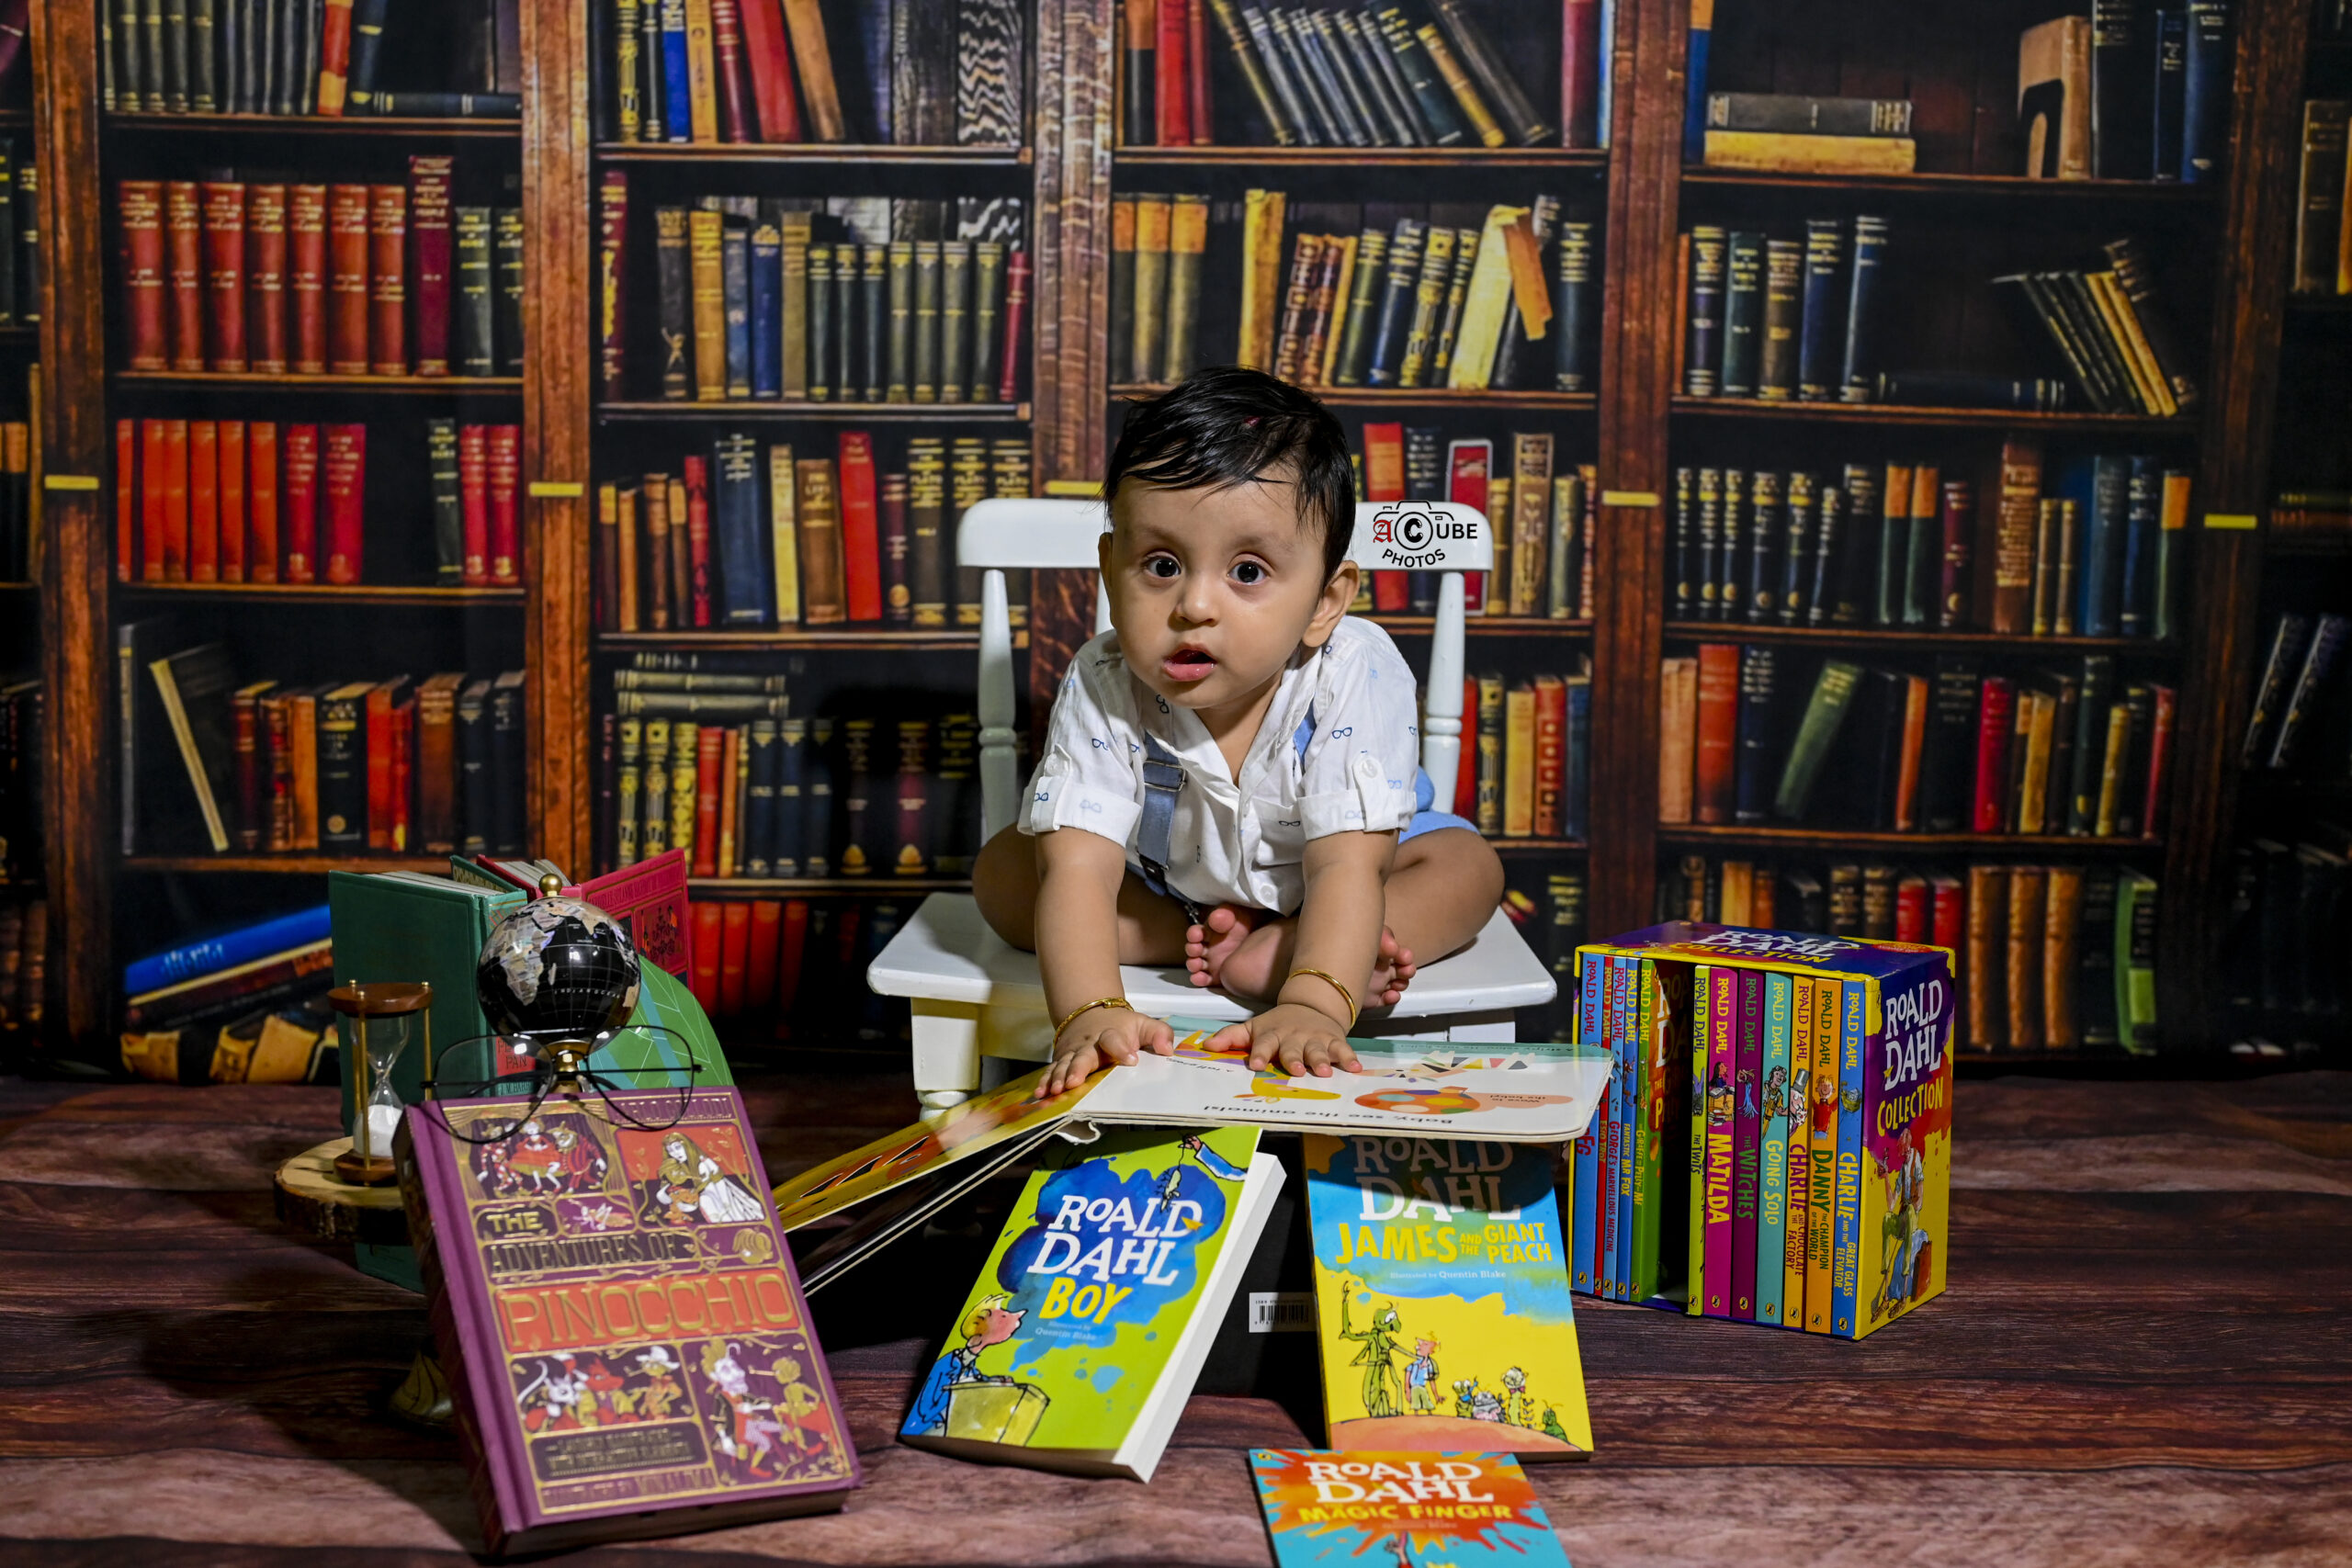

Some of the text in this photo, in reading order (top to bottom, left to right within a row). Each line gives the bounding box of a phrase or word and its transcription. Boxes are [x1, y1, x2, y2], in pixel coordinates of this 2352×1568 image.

[1669, 942, 1831, 964] COLLECTION
[1690, 935, 1836, 957] DAHL
[1719, 930, 1860, 950] ROALD
[1585, 960, 1597, 1035] ROALD DAHL
[1602, 967, 1612, 1041] ROALD DAHL
[1612, 967, 1624, 1042] ROALD DAHL
[1625, 969, 1637, 1043] ROALD DAHL
[1639, 969, 1651, 1043] ROALD DAHL
[1693, 977, 1706, 1053] ROALD DAHL
[1716, 977, 1729, 1054] ROALD DAHL
[1744, 977, 1757, 1054] ROALD DAHL
[1771, 982, 1784, 1058] ROALD DAHL
[1885, 979, 1943, 1040] ROALD
[1796, 985, 1809, 1062] ROALD DAHL
[1819, 990, 1832, 1067] ROALD DAHL
[1846, 992, 1860, 1070] ROALD DAHL
[1884, 1024, 1941, 1091] DAHL
[1877, 1077, 1943, 1136] COLLECTION
[1351, 1136, 1514, 1173] ROALD
[1577, 1127, 1595, 1156] FG
[1690, 1145, 1702, 1174] TWITS
[1621, 1177, 1631, 1196] FOX
[1622, 1159, 1632, 1174] MR
[1708, 1134, 1732, 1224] MATILDA
[1736, 1148, 1757, 1219] WITCHES
[1764, 1140, 1783, 1224] GOING SOLO
[1790, 1144, 1808, 1212] CHARLIE
[1811, 1149, 1833, 1213] DANNY
[1838, 1152, 1859, 1220] CHARLIE
[1356, 1176, 1521, 1223] DAHL
[1608, 1168, 1617, 1215] MARVELLOUS
[487, 1212, 543, 1232] THE
[1047, 1195, 1203, 1237] ROALD
[1460, 1233, 1482, 1244] AND
[1484, 1223, 1544, 1244] GIANT
[1606, 1217, 1615, 1252] MEDICINE
[490, 1233, 676, 1274] ADVENTURES OF
[1026, 1232, 1179, 1286] DAHL
[1336, 1223, 1457, 1263] JAMES
[1461, 1245, 1479, 1256] THE
[1487, 1243, 1553, 1264] PEACH
[1785, 1230, 1797, 1269] FACTORY
[1809, 1229, 1818, 1260] WORLD
[1819, 1223, 1829, 1269] CHAMPION
[1846, 1242, 1856, 1269] GREAT
[1439, 1270, 1476, 1279] Quentin
[1480, 1270, 1506, 1279] Blake
[1835, 1247, 1845, 1288] ELEVATOR
[1843, 1270, 1854, 1297] GLASS
[499, 1274, 793, 1347] PINOCCHIO
[1038, 1277, 1134, 1324] BOY
[1303, 1461, 1482, 1481] ROALD
[1308, 1480, 1494, 1504] DAHL
[1298, 1504, 1399, 1522] MAGIC
[1408, 1505, 1513, 1519] FINGER
